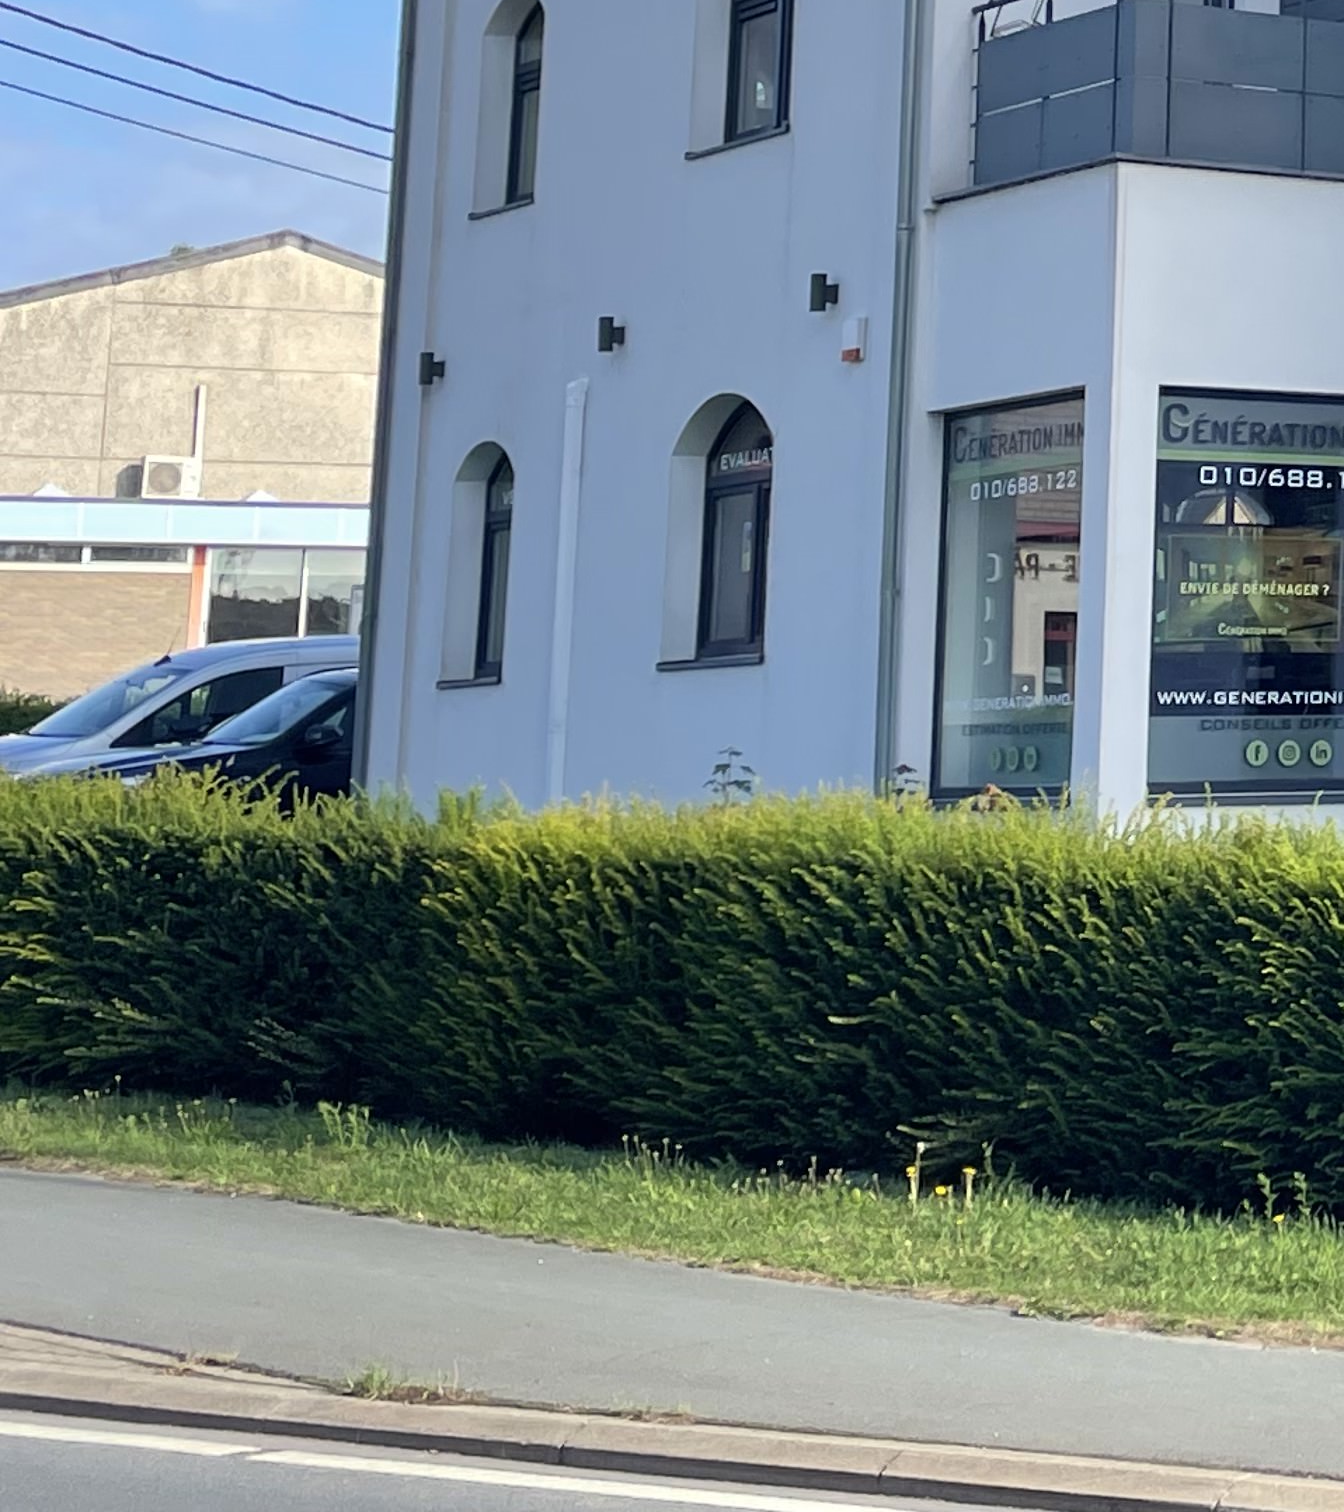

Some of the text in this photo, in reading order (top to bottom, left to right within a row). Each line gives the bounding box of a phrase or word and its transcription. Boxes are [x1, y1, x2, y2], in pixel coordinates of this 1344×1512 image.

[970, 469, 1077, 501] 010/688.122
[1180, 582, 1220, 595] ENVIE
[1223, 582, 1240, 595] DE
[1200, 718, 1292, 730] CONSEILS
